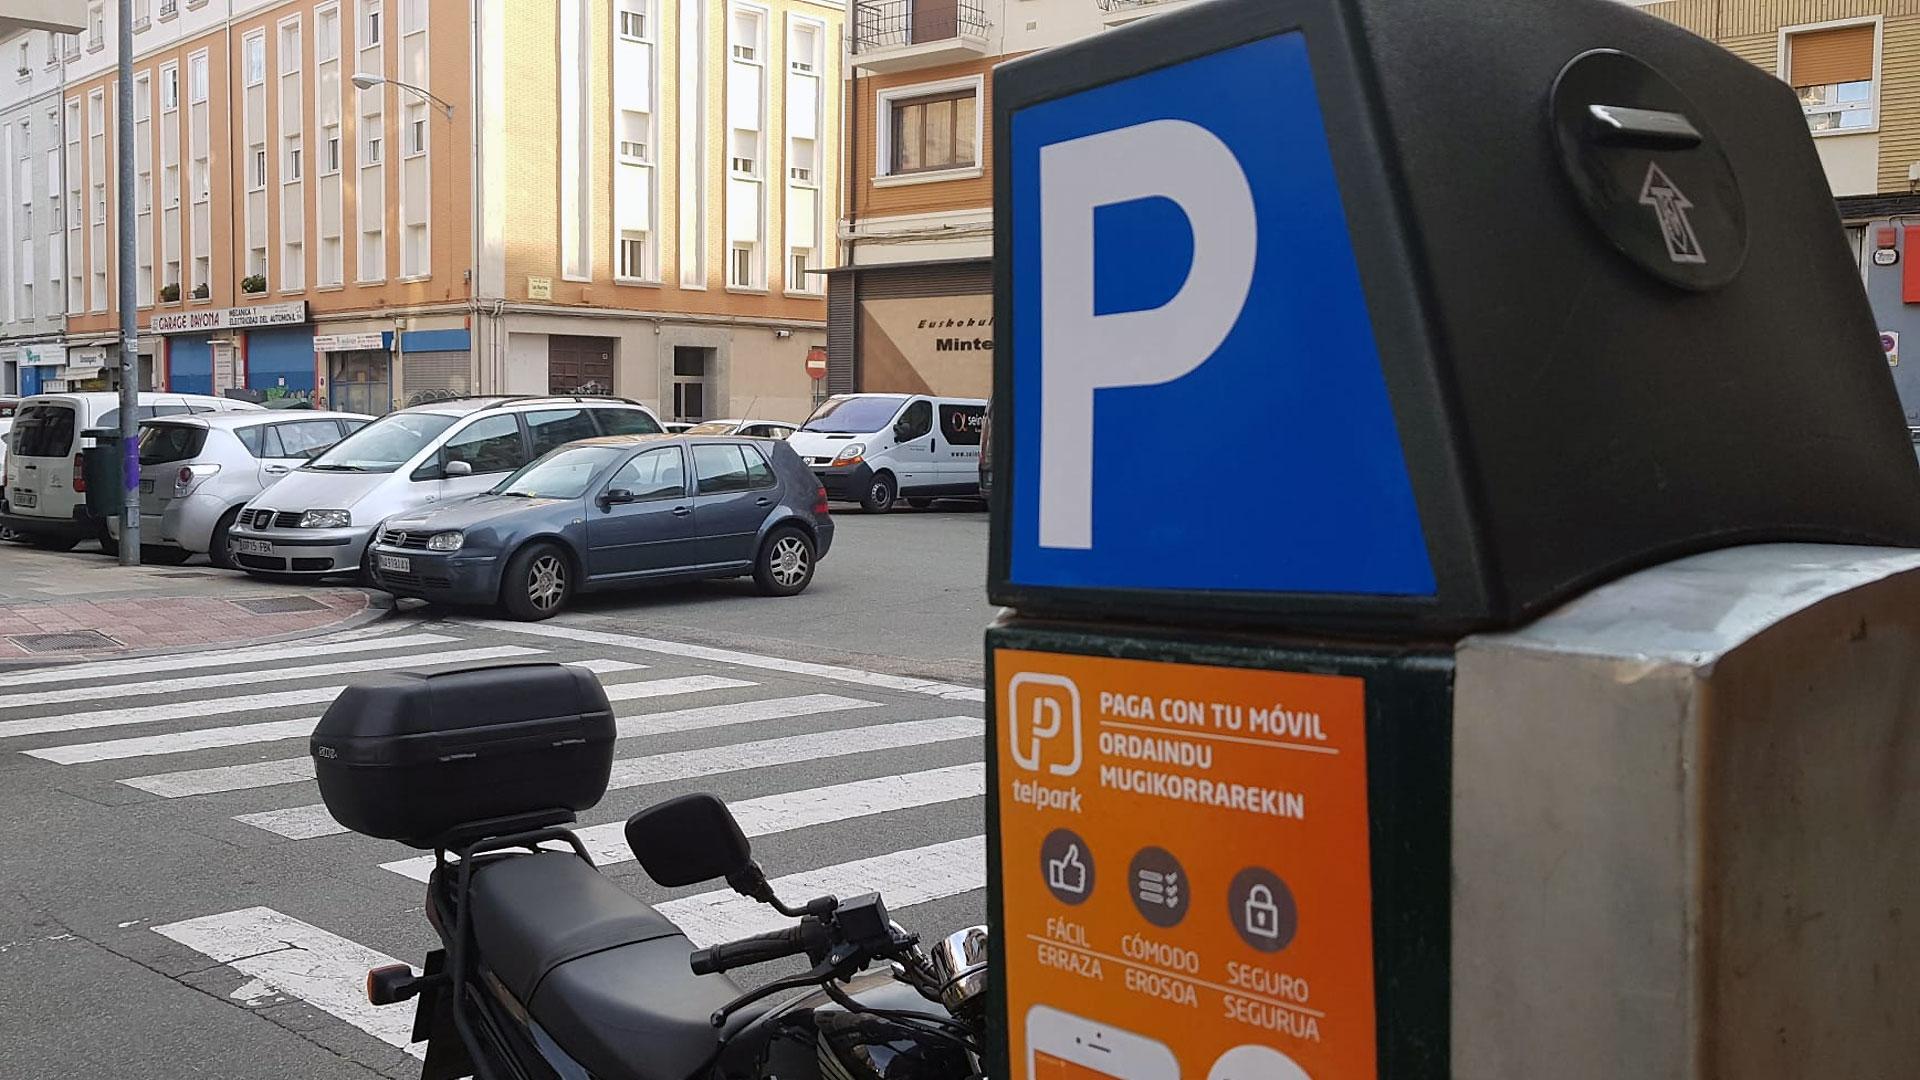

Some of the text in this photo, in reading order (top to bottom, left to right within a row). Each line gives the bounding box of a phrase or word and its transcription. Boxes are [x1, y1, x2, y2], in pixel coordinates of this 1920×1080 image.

[158, 315, 187, 330] GARAGE
[1039, 118, 1258, 550] P
[1100, 692, 1328, 740] PAGA CON TU MÓVIL
[1099, 736, 1213, 769] ORDAINDU
[1012, 779, 1082, 814] telpark
[1100, 766, 1304, 819] MUGIKORRAREKIN
[1046, 917, 1091, 948] FÁCIL
[1037, 943, 1103, 981] ERRAZA
[1121, 934, 1200, 974] CÓMODO
[1125, 968, 1198, 1008] EROSOA
[1227, 961, 1309, 1004] SEGURO
[1223, 995, 1321, 1042] SEGURUA
